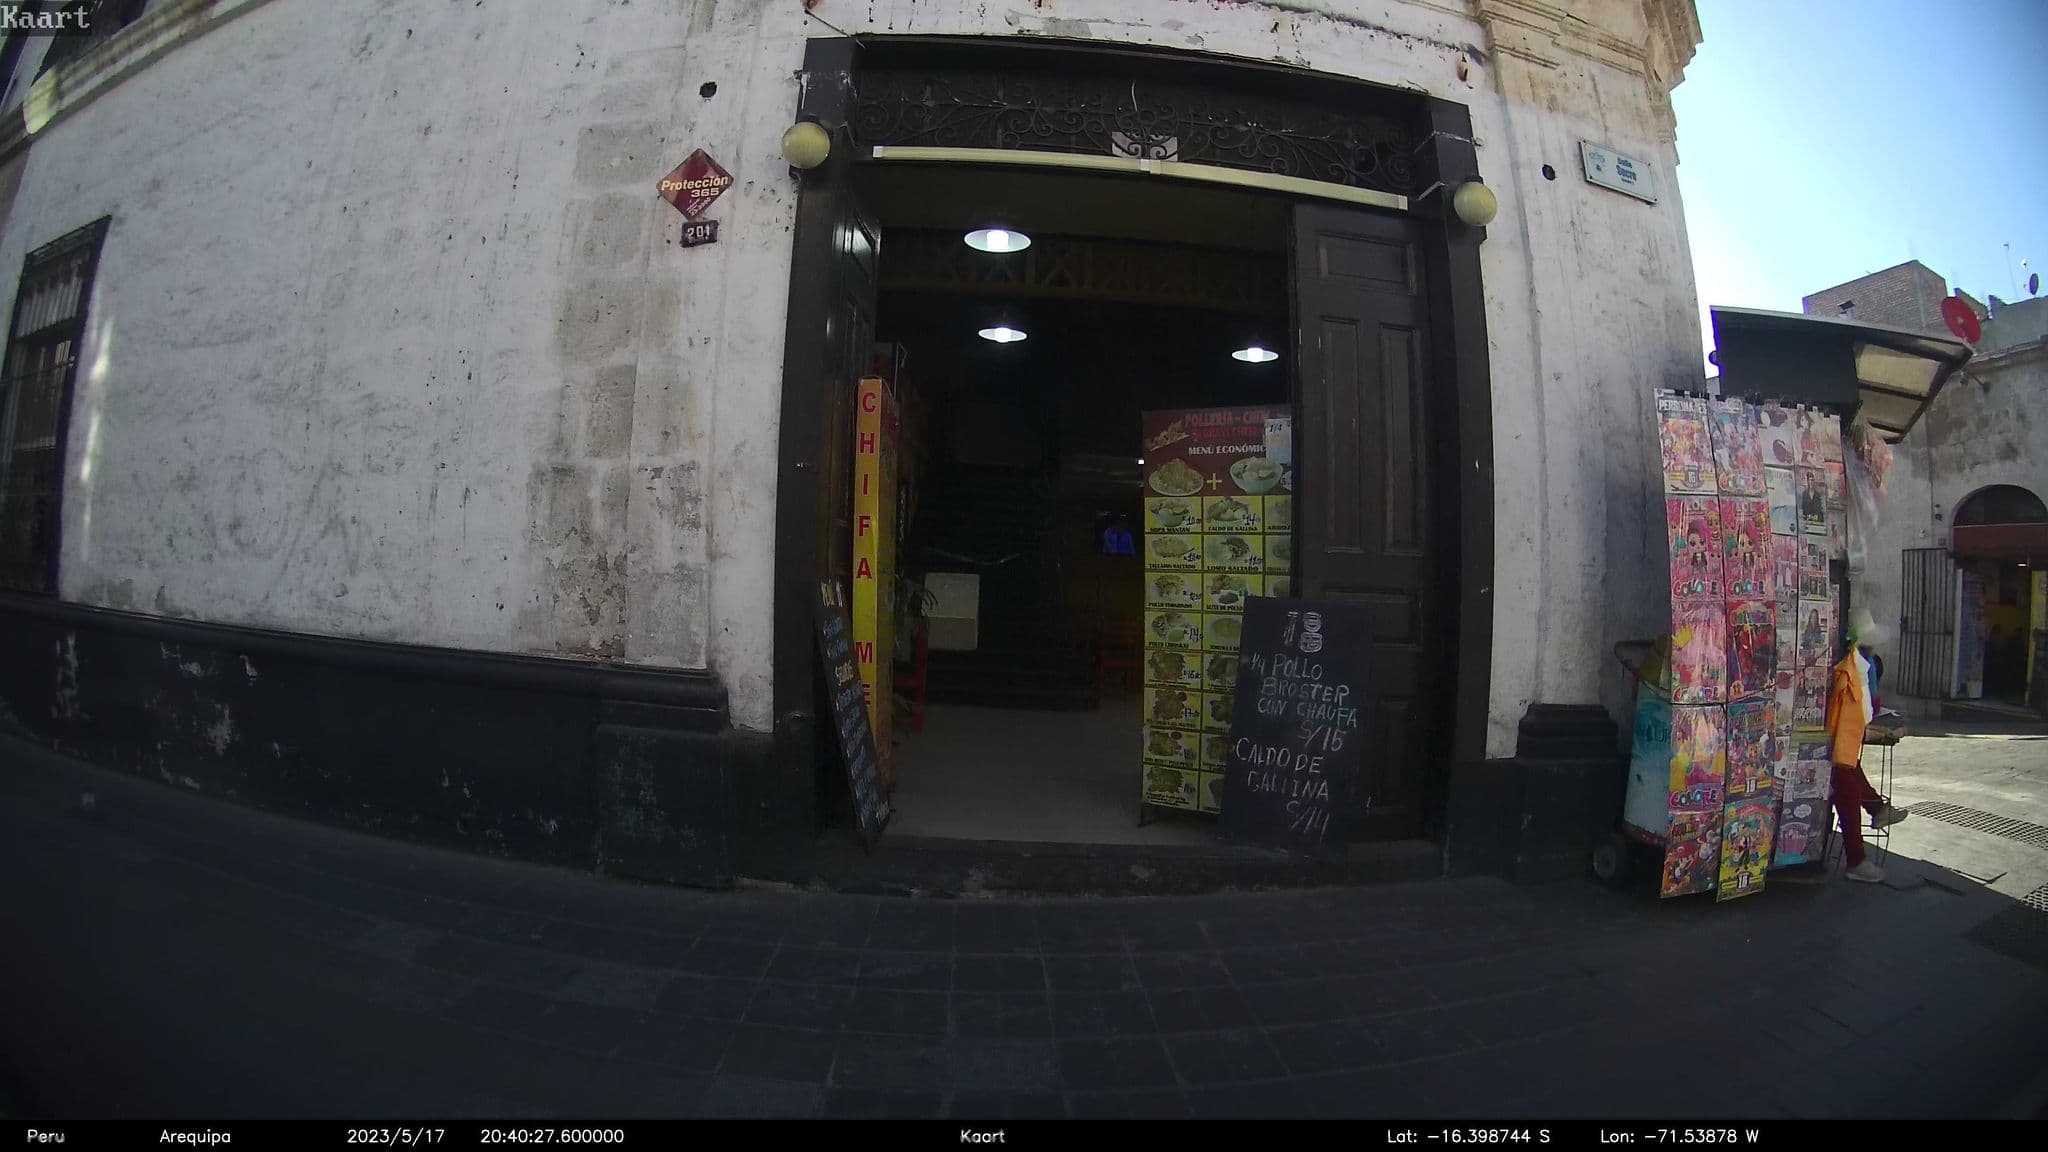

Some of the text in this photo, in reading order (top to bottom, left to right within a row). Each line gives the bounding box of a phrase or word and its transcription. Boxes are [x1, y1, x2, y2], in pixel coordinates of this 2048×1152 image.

[661, 175, 728, 191] Protección
[691, 188, 720, 198] 365
[687, 225, 710, 239] 201
[1189, 444, 1266, 455] MENÚ ECONÓMIC
[857, 392, 877, 579] CHIFA
[1272, 653, 1323, 681] POLLO
[1260, 676, 1350, 707] BROSTER
[1257, 698, 1357, 728] CON CHAUFA
[1235, 737, 1324, 773] CALDO DE
[1247, 772, 1329, 801] GALLINA
